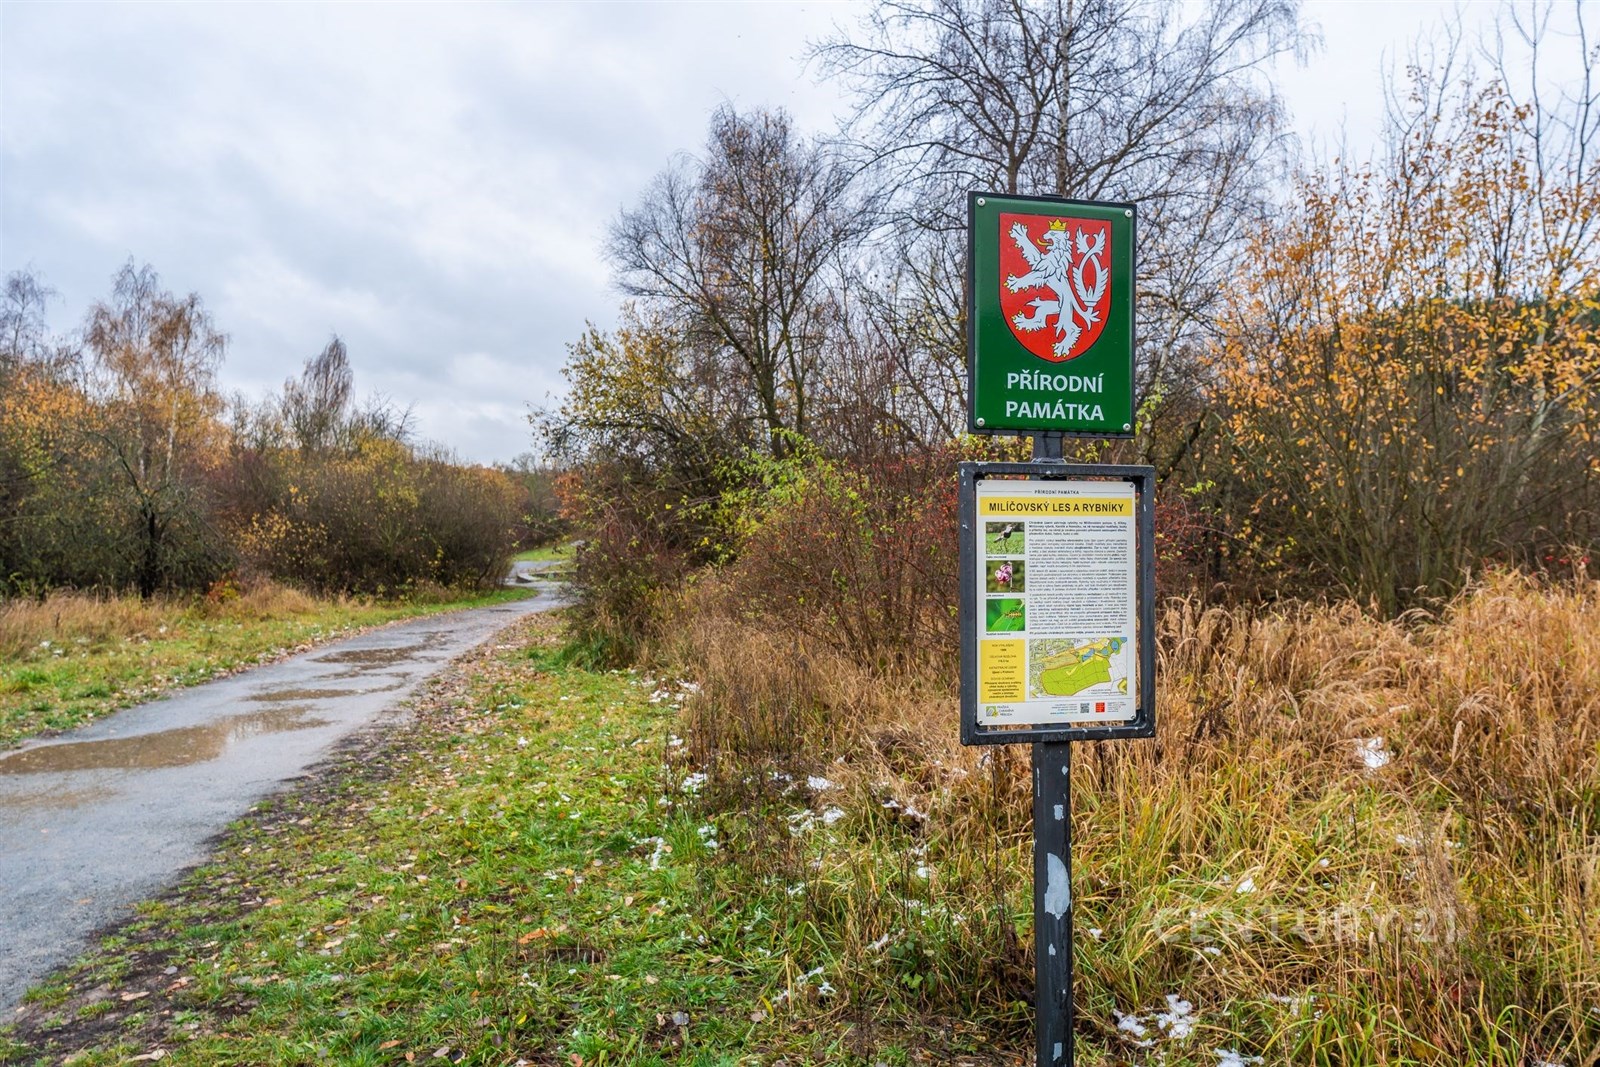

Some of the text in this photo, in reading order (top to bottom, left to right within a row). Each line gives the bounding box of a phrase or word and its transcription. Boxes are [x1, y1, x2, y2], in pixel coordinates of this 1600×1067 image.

[1007, 369, 1105, 393] PŘÍRODNÍ
[1006, 399, 1105, 421] PAMÁTKA
[988, 501, 1124, 513] MILÍČOVSKÝ LES A RYBNÍKY
